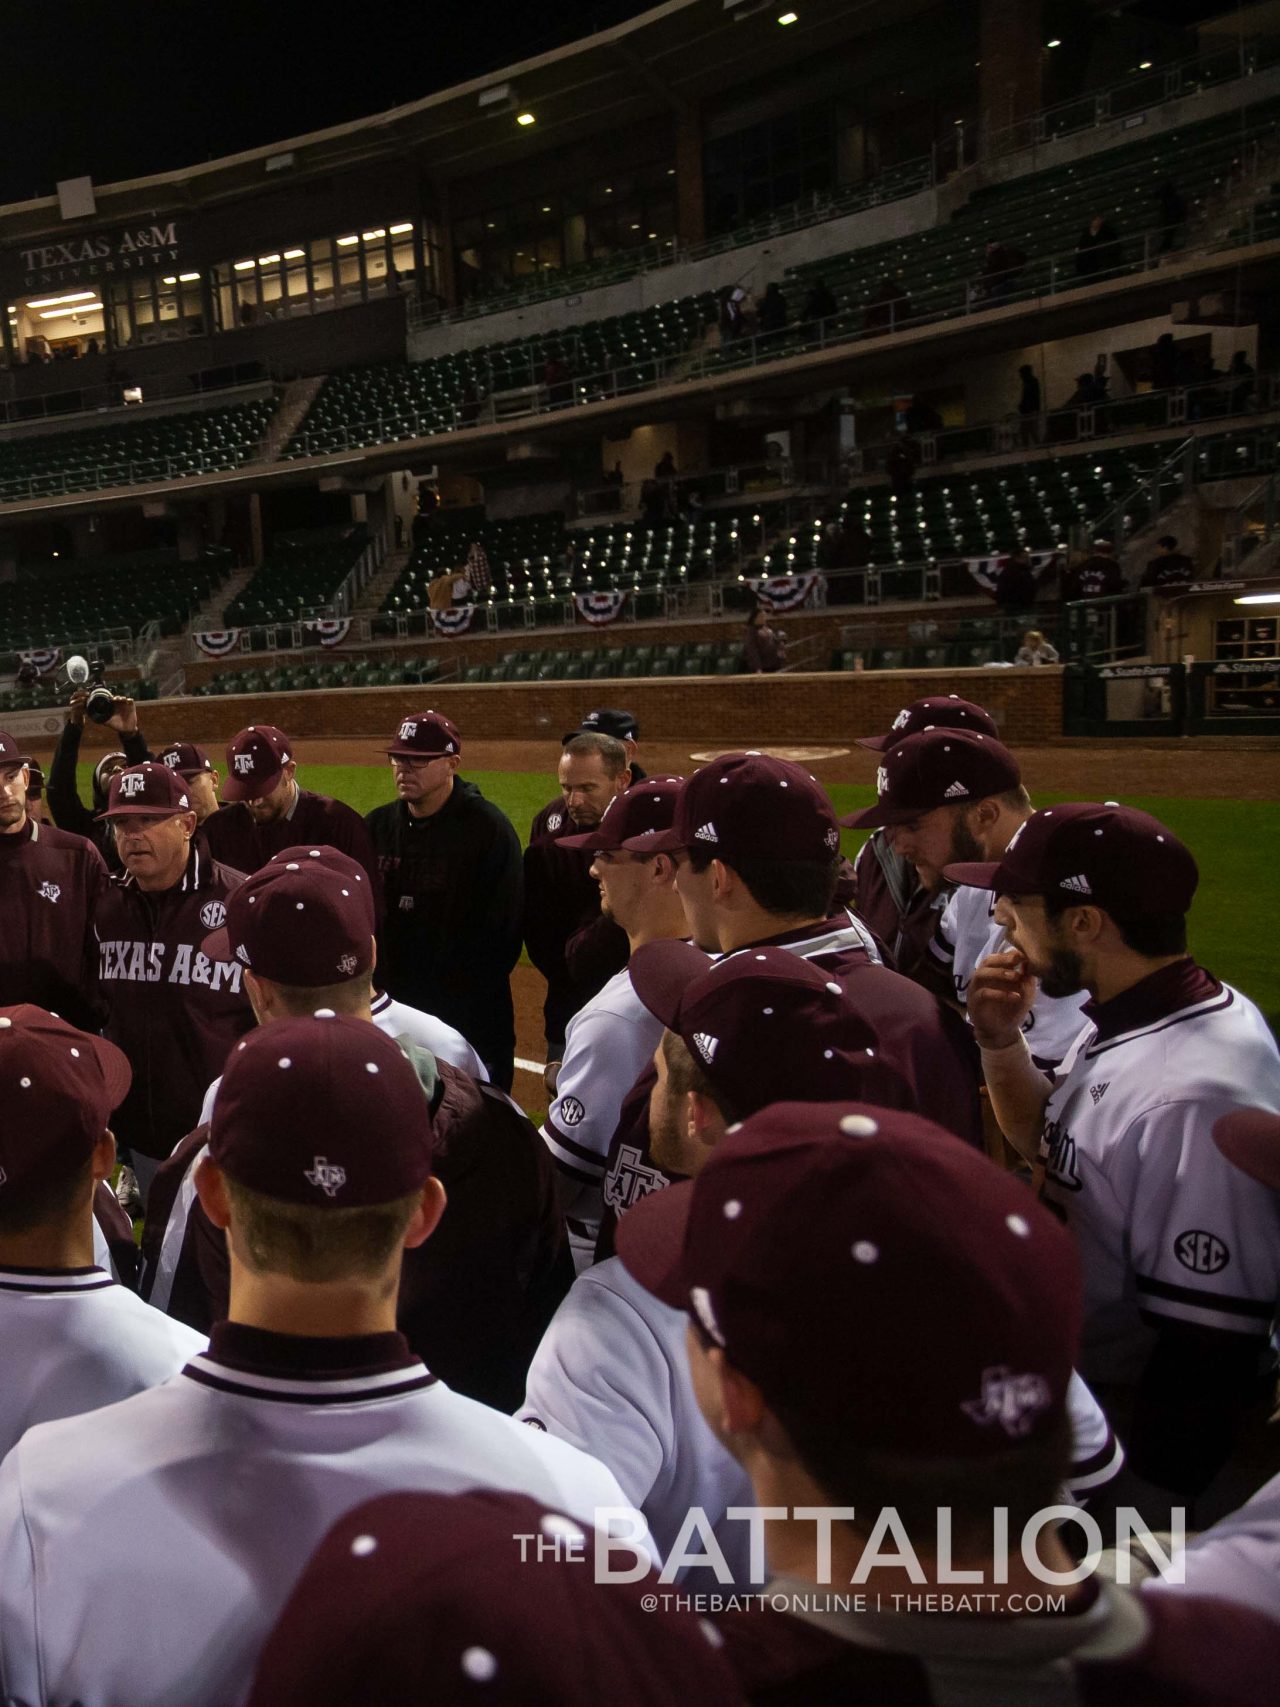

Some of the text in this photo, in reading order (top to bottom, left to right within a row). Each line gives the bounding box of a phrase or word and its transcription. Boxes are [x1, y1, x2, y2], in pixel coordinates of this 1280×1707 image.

[22, 222, 179, 271] TEXAS A&M
[24, 250, 179, 287] UNIVERSITY
[201, 901, 228, 928] SEC
[168, 943, 243, 994] A&M
[692, 1033, 714, 1065] adidas
[562, 1098, 584, 1125] SEC
[1177, 1231, 1228, 1273] SEC
